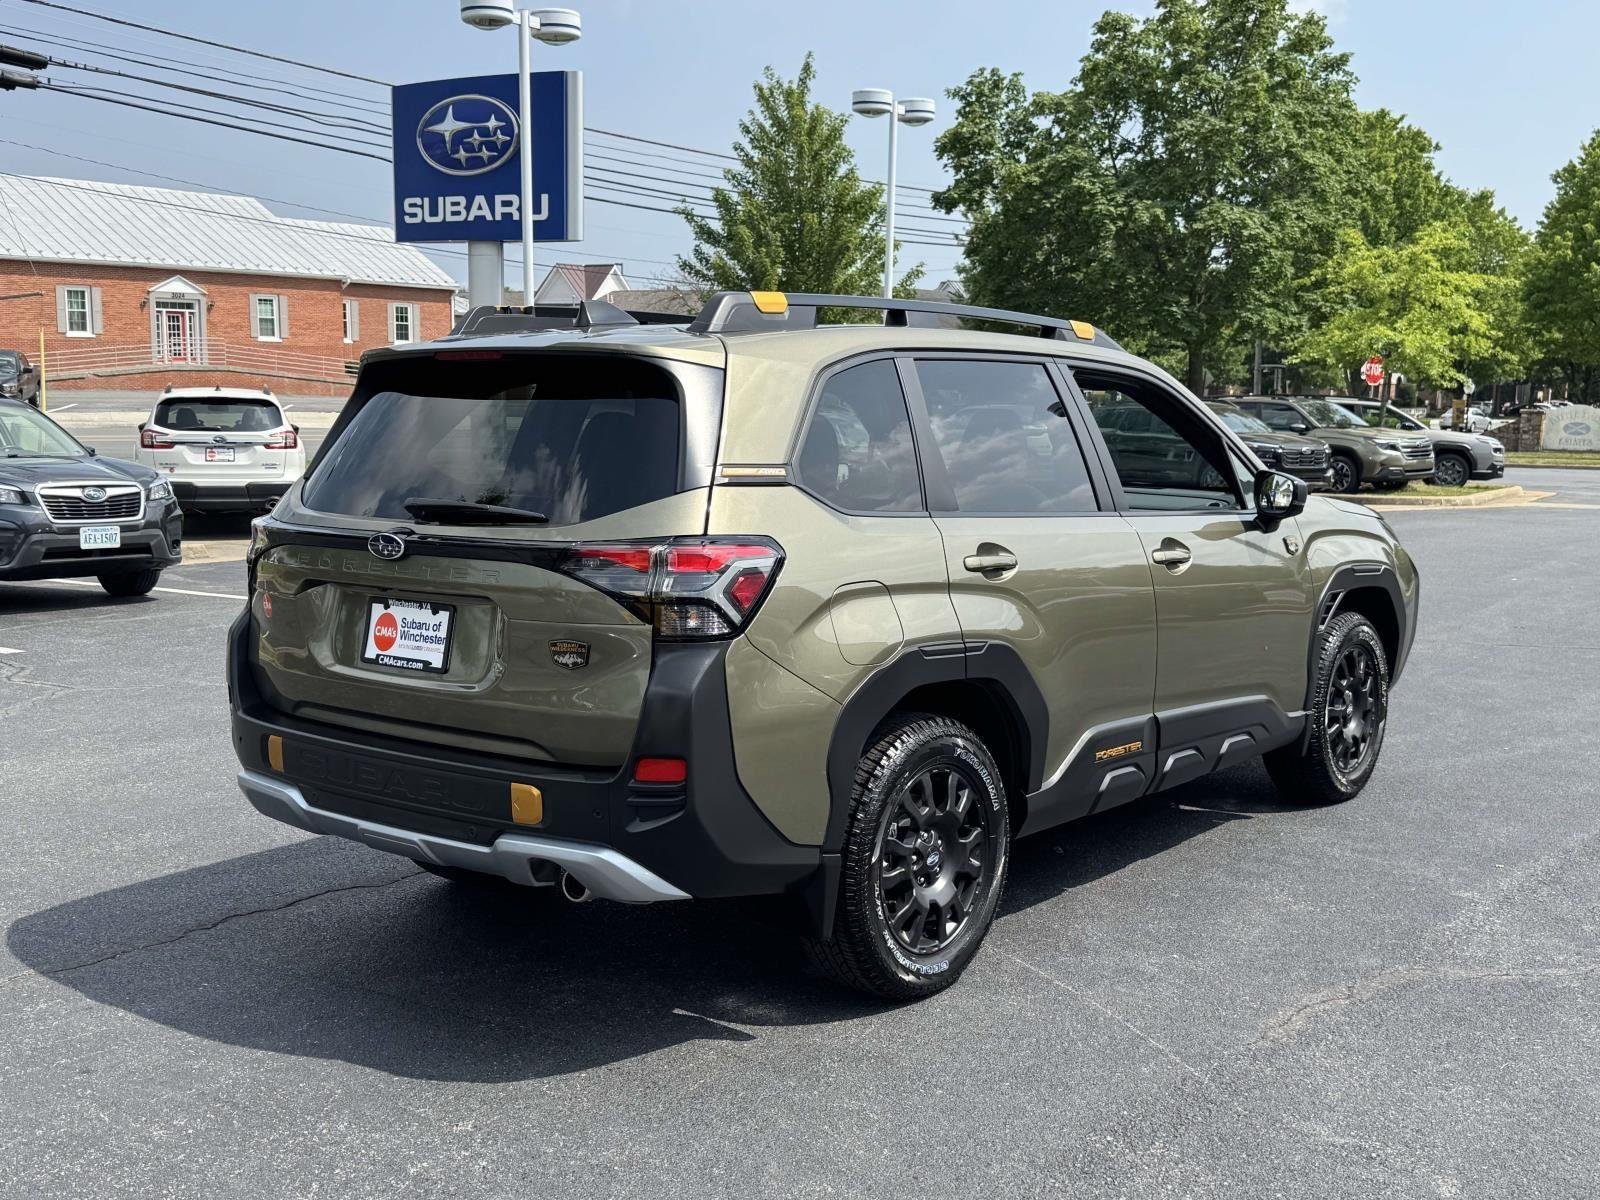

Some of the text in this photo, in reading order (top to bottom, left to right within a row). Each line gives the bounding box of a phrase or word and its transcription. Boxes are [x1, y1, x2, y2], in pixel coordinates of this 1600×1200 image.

[403, 193, 549, 223] SUBARU
[84, 532, 118, 545] AFA-1507
[423, 602, 431, 610] VA
[375, 626, 397, 638] CMA's
[401, 617, 442, 632] Subaru of
[400, 629, 446, 645] Winchester
[379, 656, 423, 669] CMAcars.com
[1095, 741, 1142, 761] FORESTER
[954, 746, 1000, 811] YOKOHAMA
